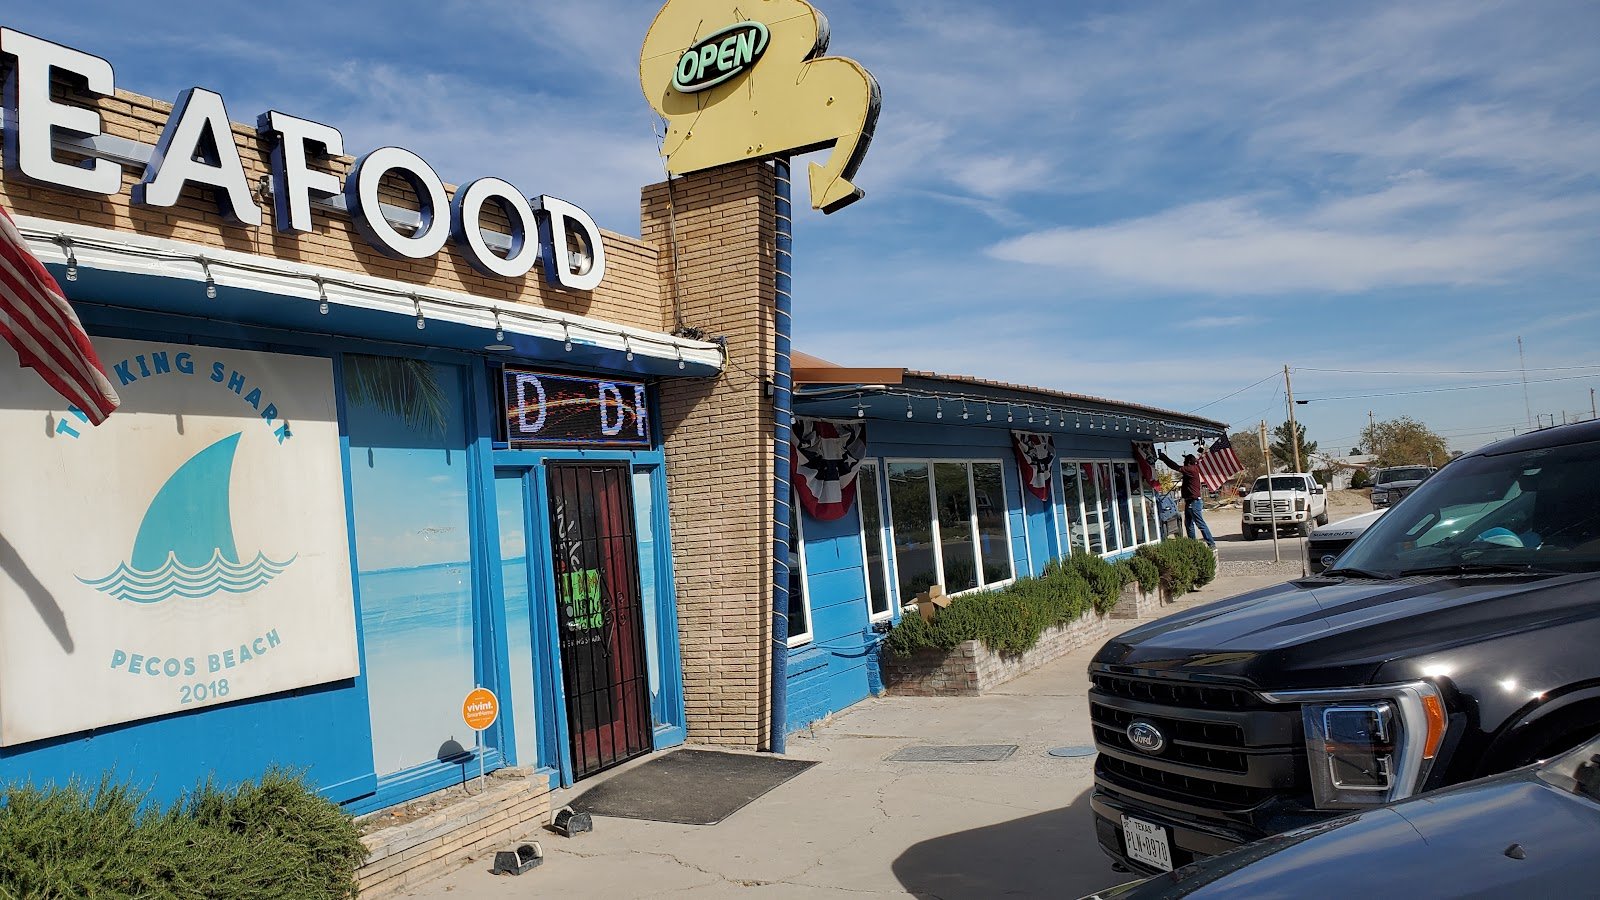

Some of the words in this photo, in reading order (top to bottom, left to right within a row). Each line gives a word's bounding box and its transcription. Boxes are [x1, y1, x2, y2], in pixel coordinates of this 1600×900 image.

[677, 29, 757, 84] OPEN
[113, 351, 194, 386] KING
[210, 361, 293, 446] SHARK
[110, 649, 196, 677] PECOS
[207, 628, 281, 673] BEACH
[179, 678, 230, 704] 2018
[1133, 727, 1153, 746] Ford
[1134, 821, 1153, 834] TEXAS
